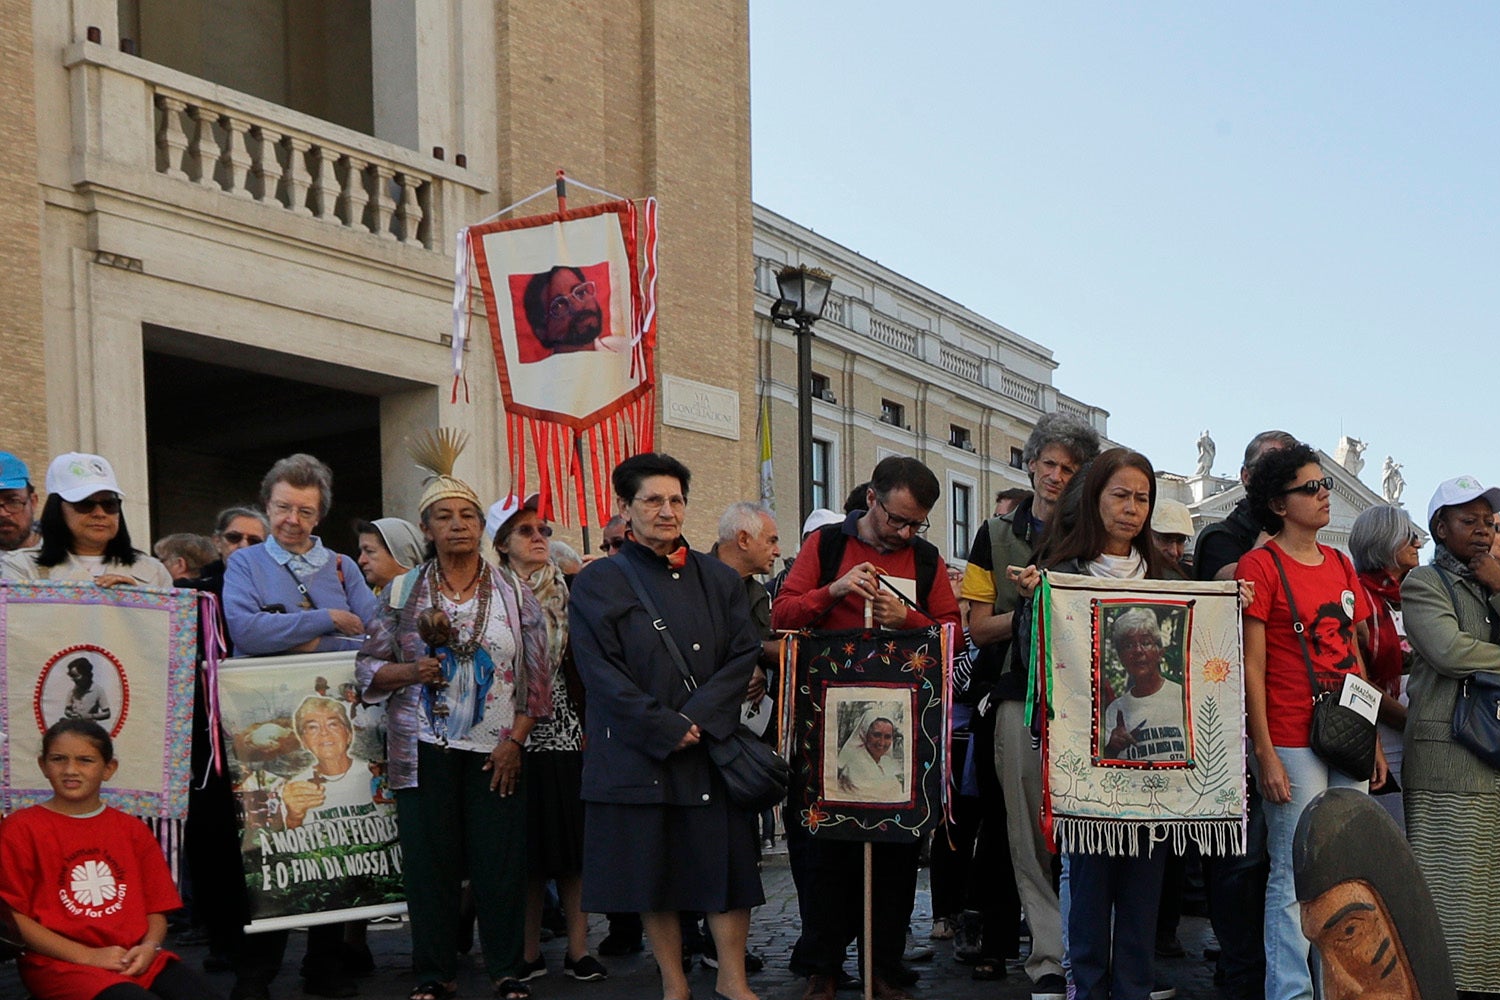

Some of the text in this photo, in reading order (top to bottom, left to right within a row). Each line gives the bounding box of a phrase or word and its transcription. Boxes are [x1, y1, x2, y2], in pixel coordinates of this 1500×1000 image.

[259, 832, 273, 857] A
[272, 823, 326, 854] MORTE
[324, 818, 353, 847] DA
[262, 857, 271, 891] É
[276, 861, 289, 889] O
[290, 858, 322, 884] FIM
[321, 856, 345, 880] DA
[344, 850, 389, 877] NOSSA
[59, 889, 84, 915] caring
[85, 908, 103, 918] for
